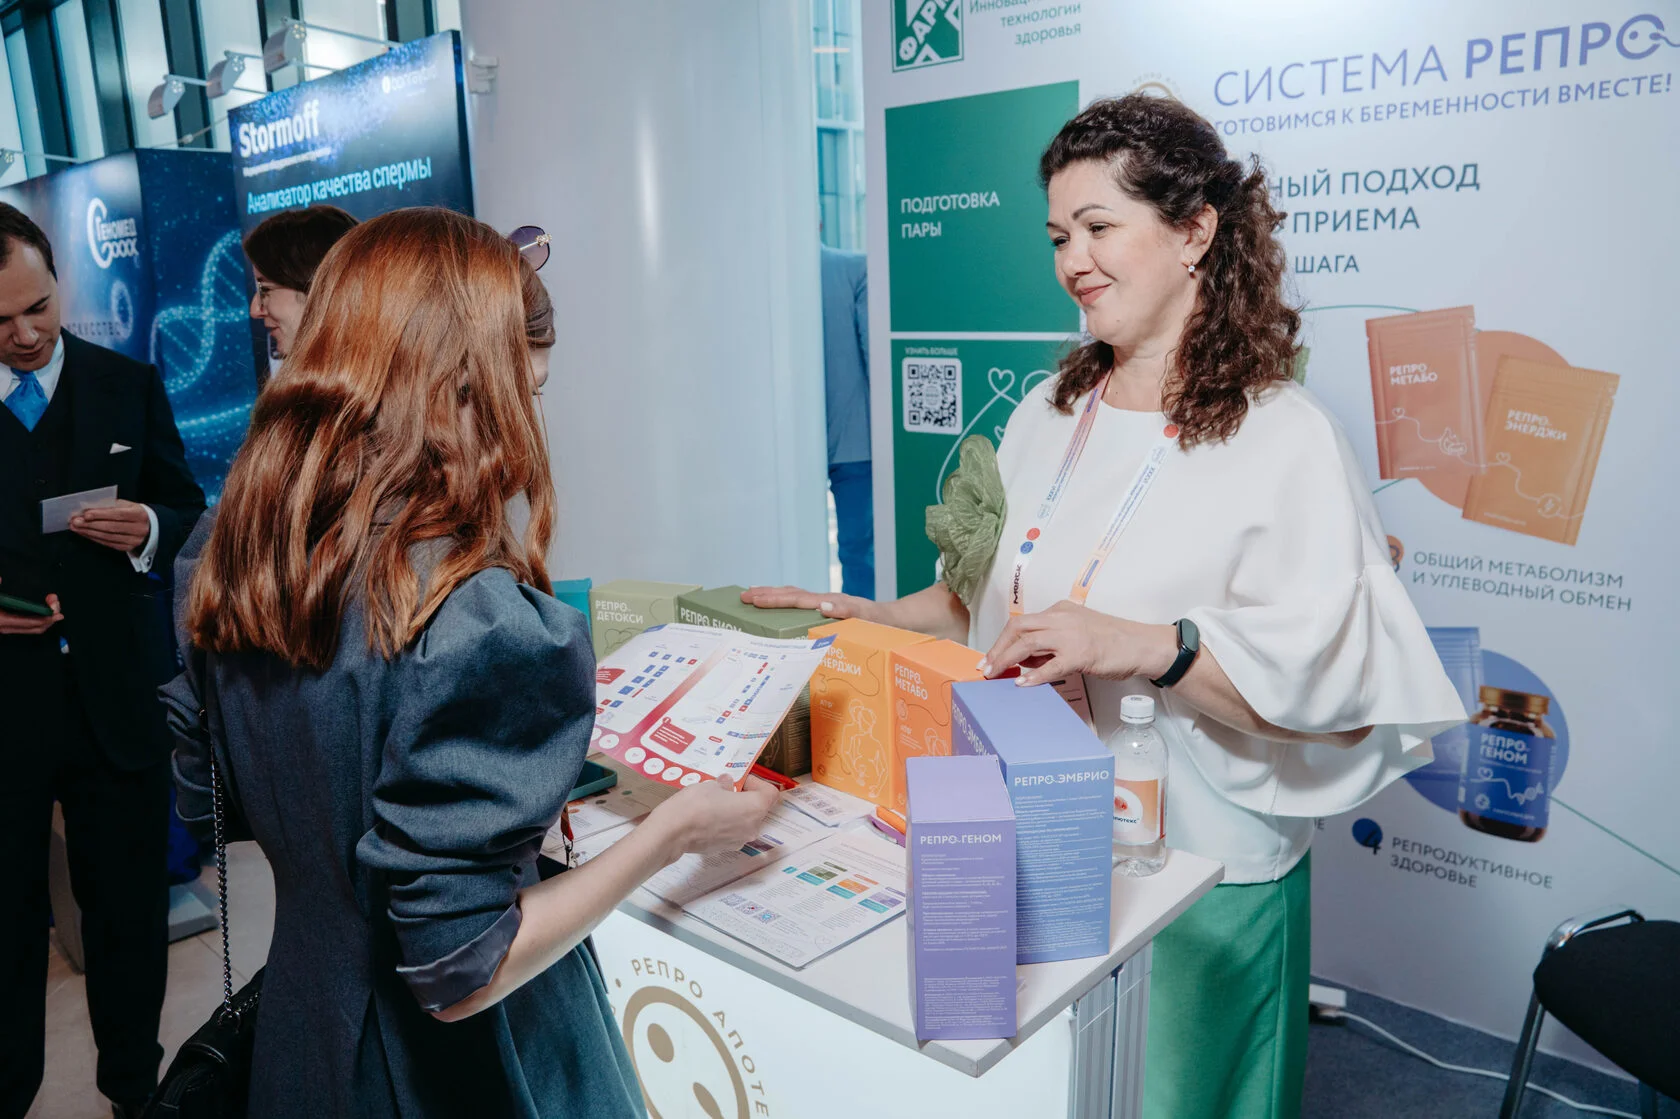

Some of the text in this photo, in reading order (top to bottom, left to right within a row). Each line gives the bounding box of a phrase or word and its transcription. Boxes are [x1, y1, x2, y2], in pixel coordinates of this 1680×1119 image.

[1000, 4, 1081, 28] технологии
[1015, 23, 1081, 46] здоровья
[1213, 14, 1665, 107] СИСТЕМА РЕПРО
[1215, 73, 1672, 136] ГОТОВИМСЯ К БЕРЕМЕННОСТИ ВМЕСТЕ!
[239, 99, 320, 158] Stormoff
[247, 156, 432, 215] Анализатор качества спермы
[1267, 163, 1480, 198] НЫЙ ПОДХОД
[901, 191, 1000, 214] ПОДГОТОВКА
[902, 221, 941, 239] ПАРЫ
[1293, 206, 1420, 233] ПРИЕМА
[1295, 255, 1359, 274] ШАГА
[1389, 363, 1428, 376] РЕПРО
[1391, 372, 1438, 385] МЕТАБО
[1508, 409, 1549, 426] РЕПРО
[1505, 420, 1567, 440] ЭНЕРДЖИ
[1414, 550, 1623, 588] ОБЩИЙ МЕТАБОЛИЗМ
[1413, 571, 1632, 612] И УГЛЕВОДНЫЙ ОБМЕН
[595, 600, 627, 612] РЕПРО
[681, 607, 709, 626] РЕПРО
[596, 611, 644, 625] ДЕТОКСИ
[820, 658, 862, 676] НЕРДЖИ
[895, 663, 921, 684] РЕПРО
[895, 676, 928, 700] МЕТАБО
[1481, 733, 1526, 752] РЕПРО
[1480, 745, 1528, 764] ГЕНОМ
[1014, 770, 1109, 787] РЕПРО ЭМБРИО
[920, 834, 1002, 845] РЕПРО ГЕНОМ
[1391, 854, 1477, 888] ЗДОРОВЬЕ
[1392, 836, 1553, 890] РЕПРОДУКТИВНОЕ
[631, 957, 703, 998] РЕПРО
[712, 1010, 769, 1118] АПОТЕ
